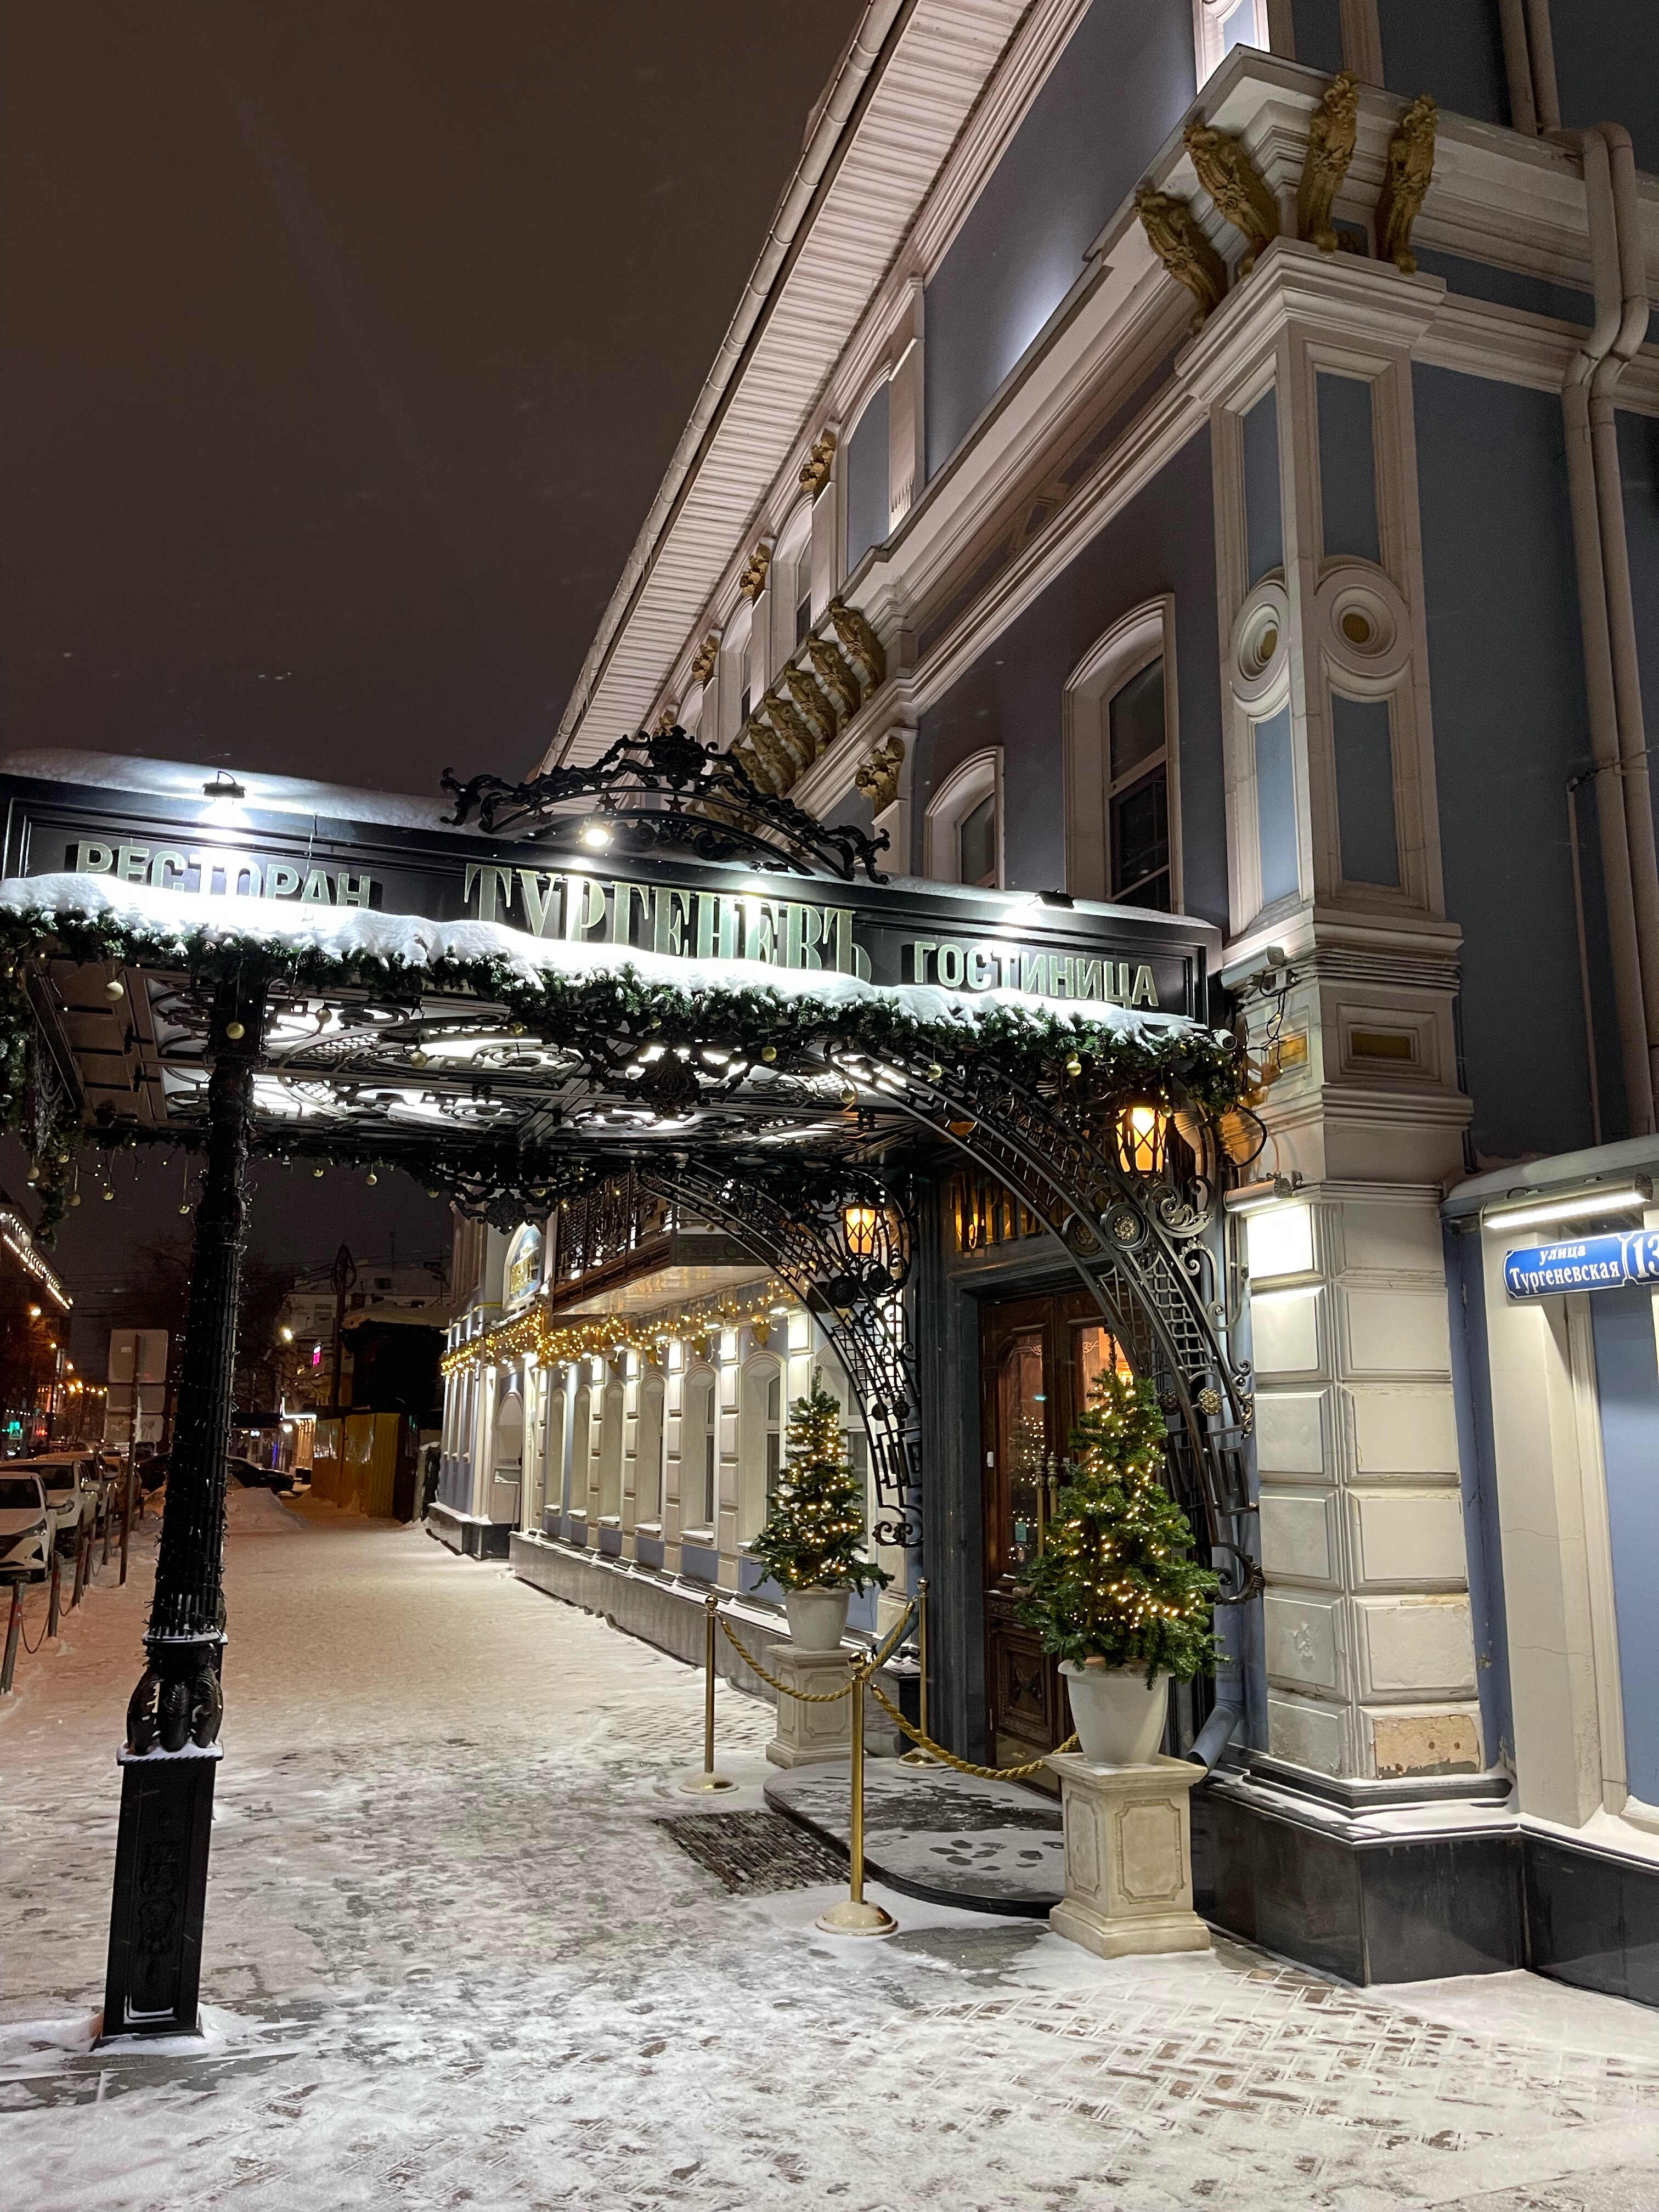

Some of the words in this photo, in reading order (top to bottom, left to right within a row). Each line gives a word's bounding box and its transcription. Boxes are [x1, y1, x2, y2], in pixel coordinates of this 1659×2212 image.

[914, 940, 1159, 1010] ГОСТИНИЦА
[1539, 1245, 1586, 1266] улица
[1509, 1261, 1621, 1294] Тургеневская
